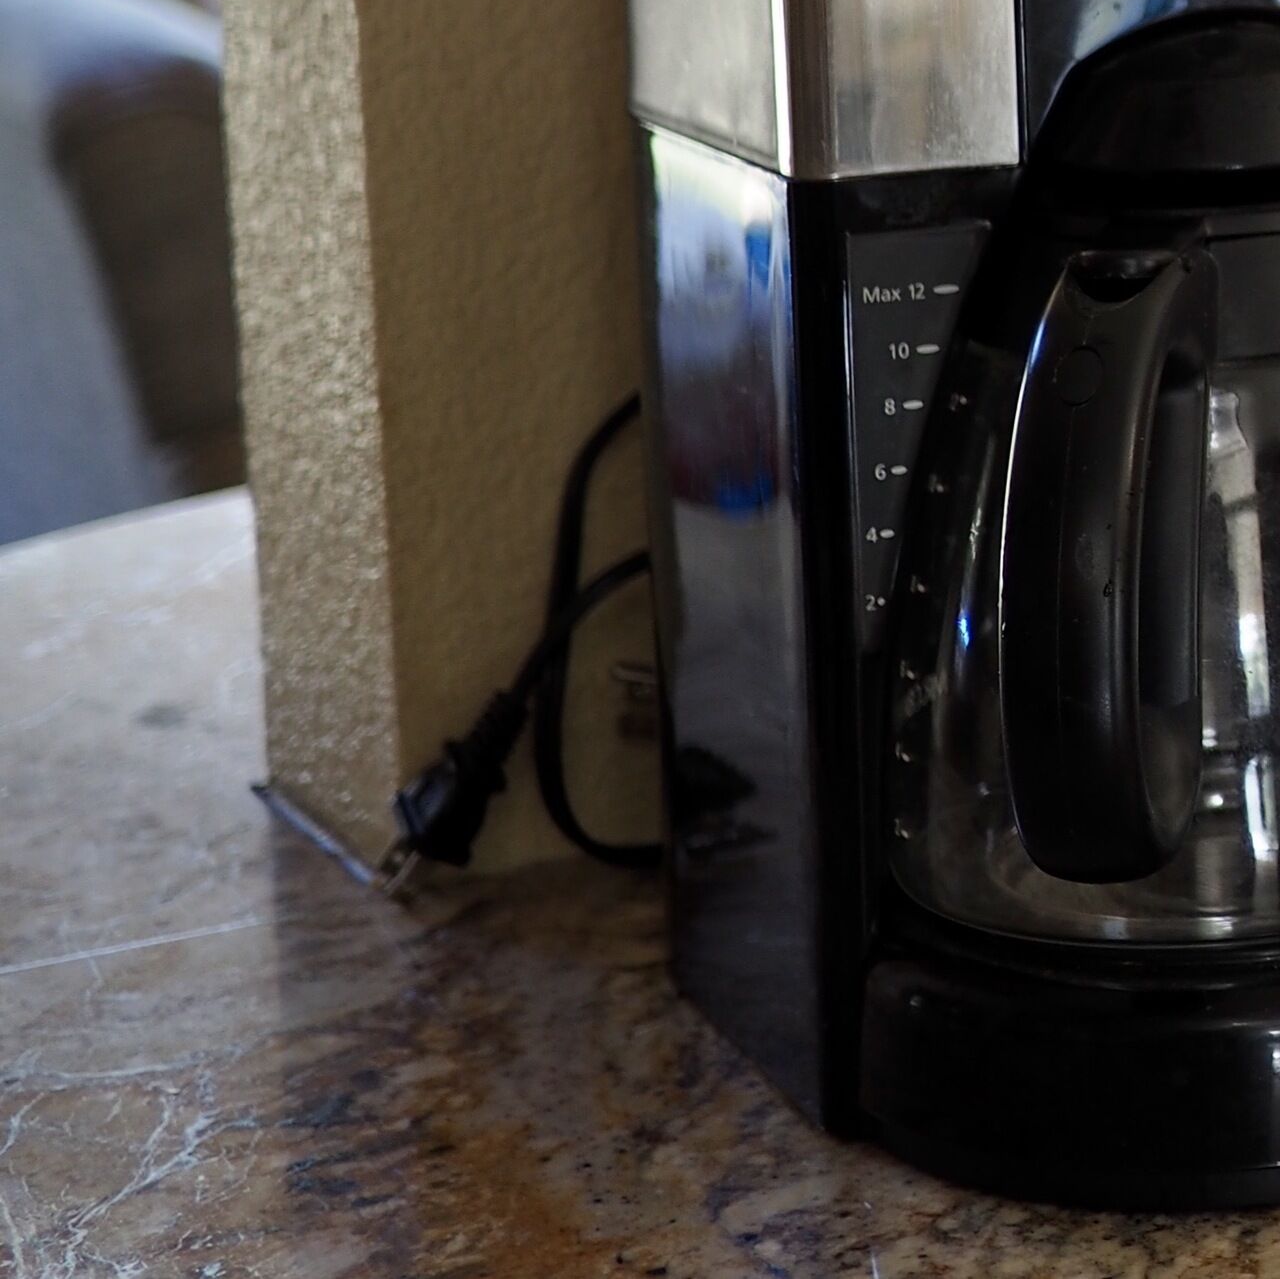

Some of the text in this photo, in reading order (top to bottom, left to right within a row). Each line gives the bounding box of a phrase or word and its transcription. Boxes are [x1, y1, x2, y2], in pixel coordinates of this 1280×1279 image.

[862, 282, 926, 305] Max 12
[888, 341, 910, 360] 10
[884, 397, 896, 416] 8
[874, 463, 887, 481] 6
[865, 526, 878, 544] 4
[865, 593, 877, 612] 2
